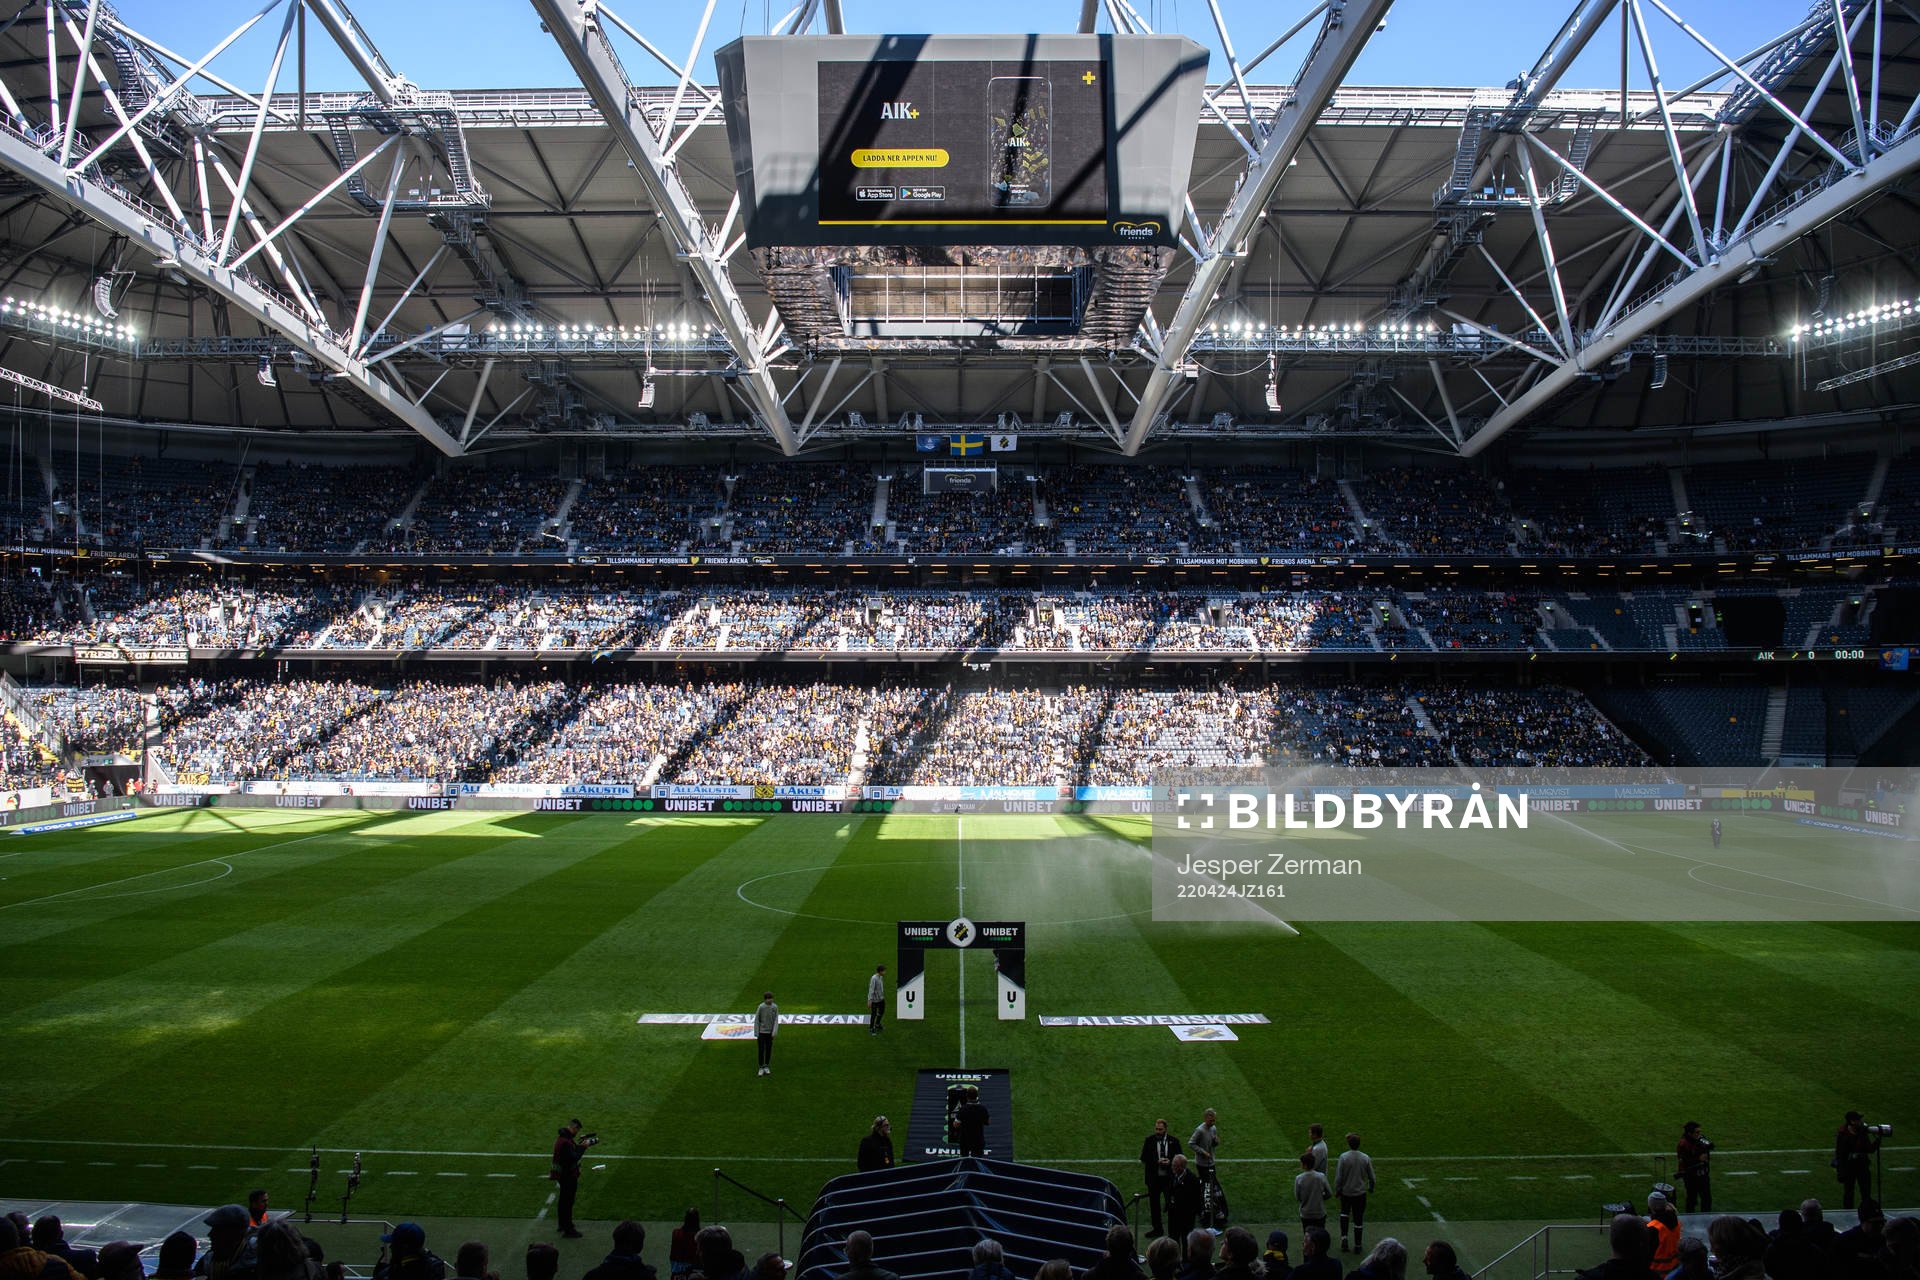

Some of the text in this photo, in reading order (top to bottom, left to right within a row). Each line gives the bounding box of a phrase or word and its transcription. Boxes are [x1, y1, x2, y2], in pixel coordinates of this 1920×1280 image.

[913, 191, 942, 199] Google Play
[1120, 226, 1153, 236] friends
[90, 550, 117, 558] FRIENDS
[119, 551, 139, 559] ARENA
[1786, 552, 1830, 560] TILLSAMMANS
[1757, 650, 1865, 660] AIK 0 00:00
[1615, 787, 1660, 798] MALMQVIST
[154, 795, 201, 806] UNIBET
[275, 796, 323, 807] UNIBET
[408, 797, 457, 809] UNIBET
[533, 799, 583, 810] UNIBET
[665, 800, 714, 811] UNIBET
[1654, 800, 1702, 810] UNIBET
[63, 801, 96, 816] UNIBET
[792, 801, 842, 812] UNIBET
[1003, 801, 1054, 813] UNIBET
[1530, 801, 1580, 811] UNIBET
[1865, 811, 1900, 826] UNIBET
[904, 927, 940, 936] UNIBET
[983, 927, 1018, 936] UNIBET
[678, 1014, 865, 1024] ALLSVNSKAN
[1077, 1013, 1262, 1026] ALLSVENSKAN
[925, 1147, 992, 1155] UNIT
